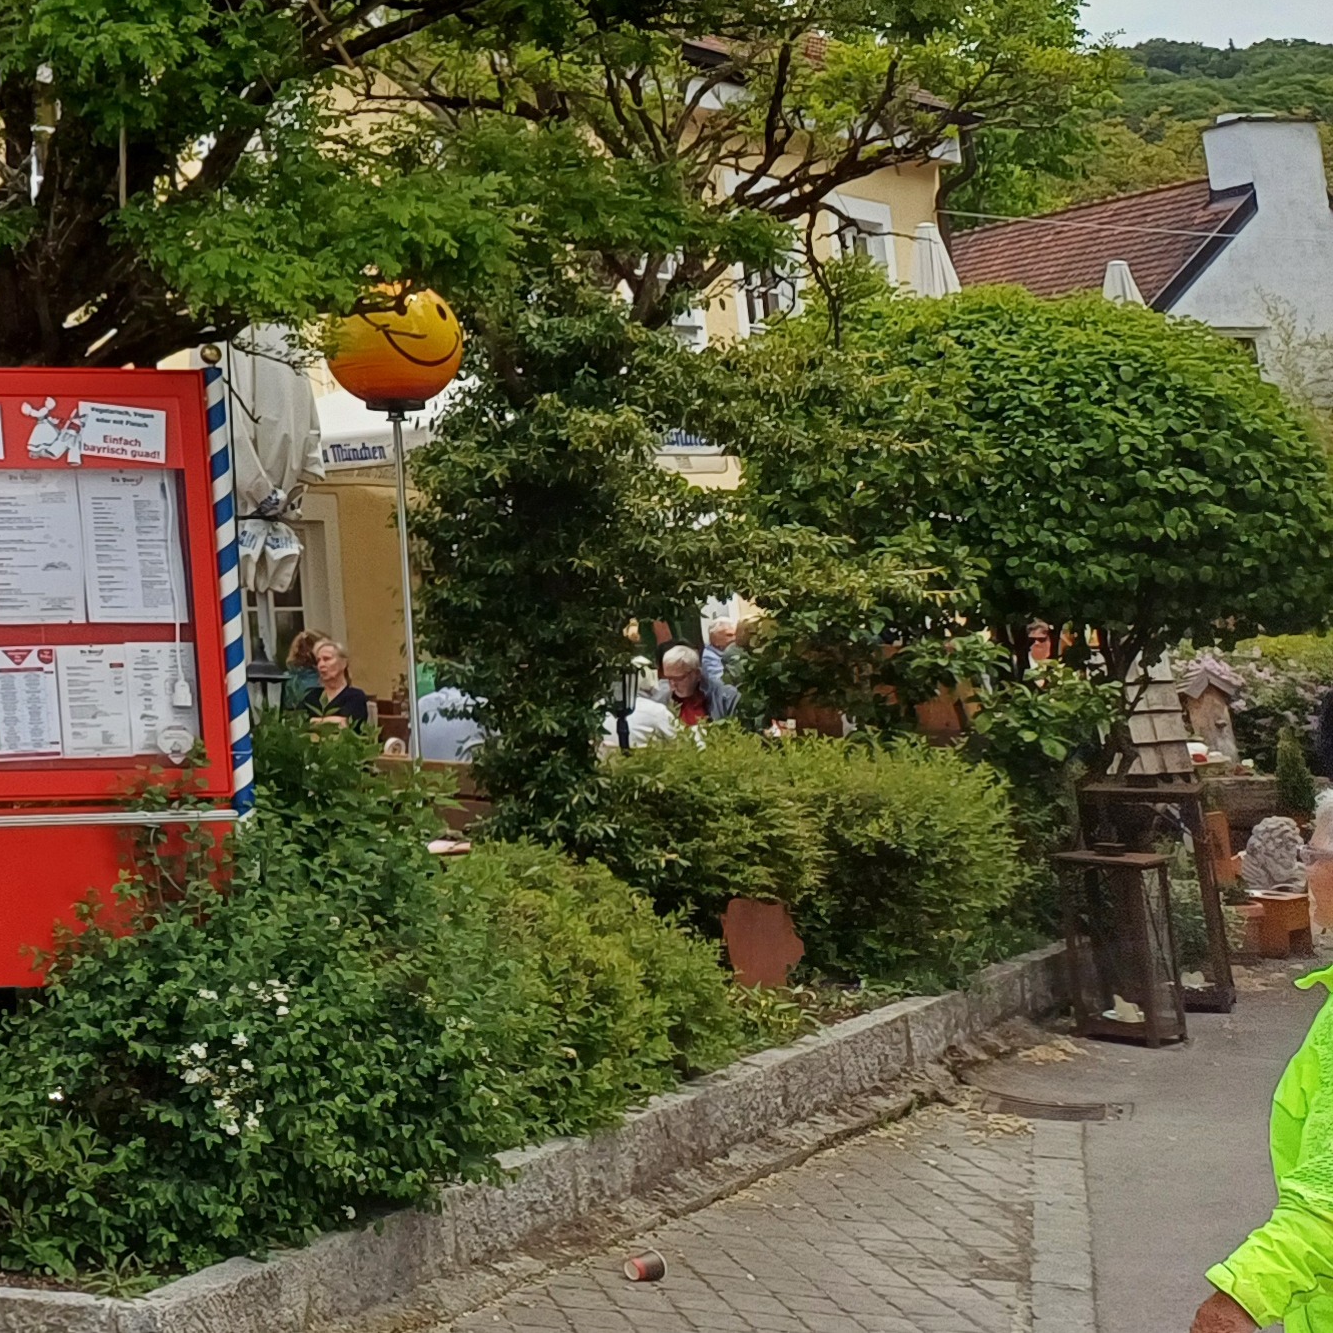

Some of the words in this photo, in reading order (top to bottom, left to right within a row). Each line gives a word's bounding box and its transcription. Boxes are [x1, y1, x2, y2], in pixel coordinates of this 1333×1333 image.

[103, 435, 141, 447] Einfach
[83, 443, 127, 456] bayrisch
[131, 449, 160, 459] guad!
[330, 443, 386, 462] München
